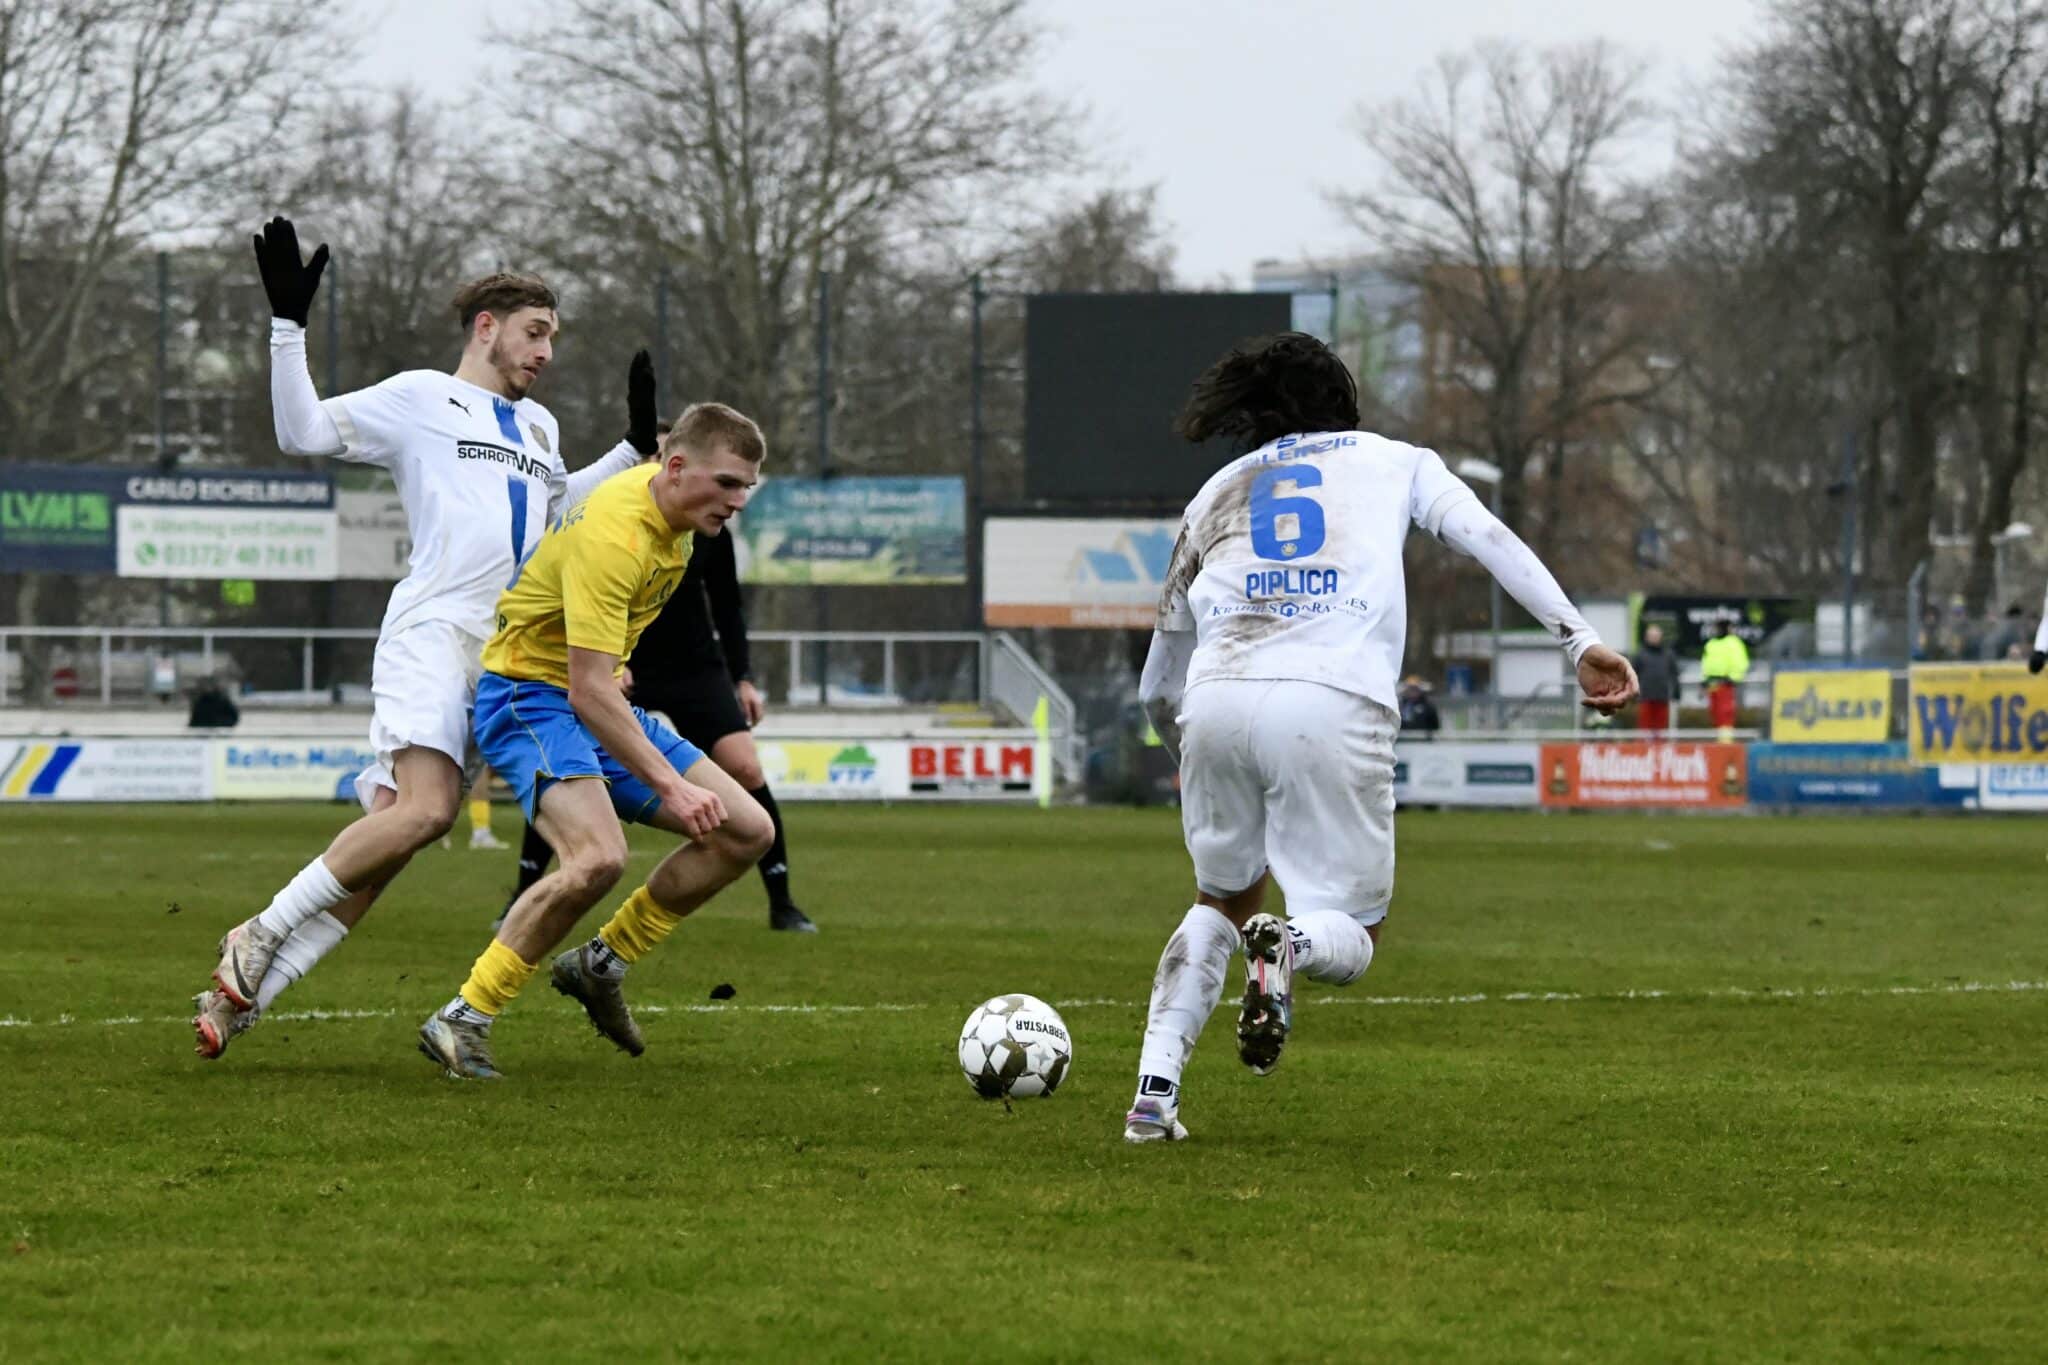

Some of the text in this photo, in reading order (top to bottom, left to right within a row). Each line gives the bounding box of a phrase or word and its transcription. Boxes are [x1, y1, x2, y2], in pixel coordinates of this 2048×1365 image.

[1250, 463, 1326, 561] 6
[1245, 569, 1338, 599] PIPLICA
[909, 747, 1034, 778] BELM
